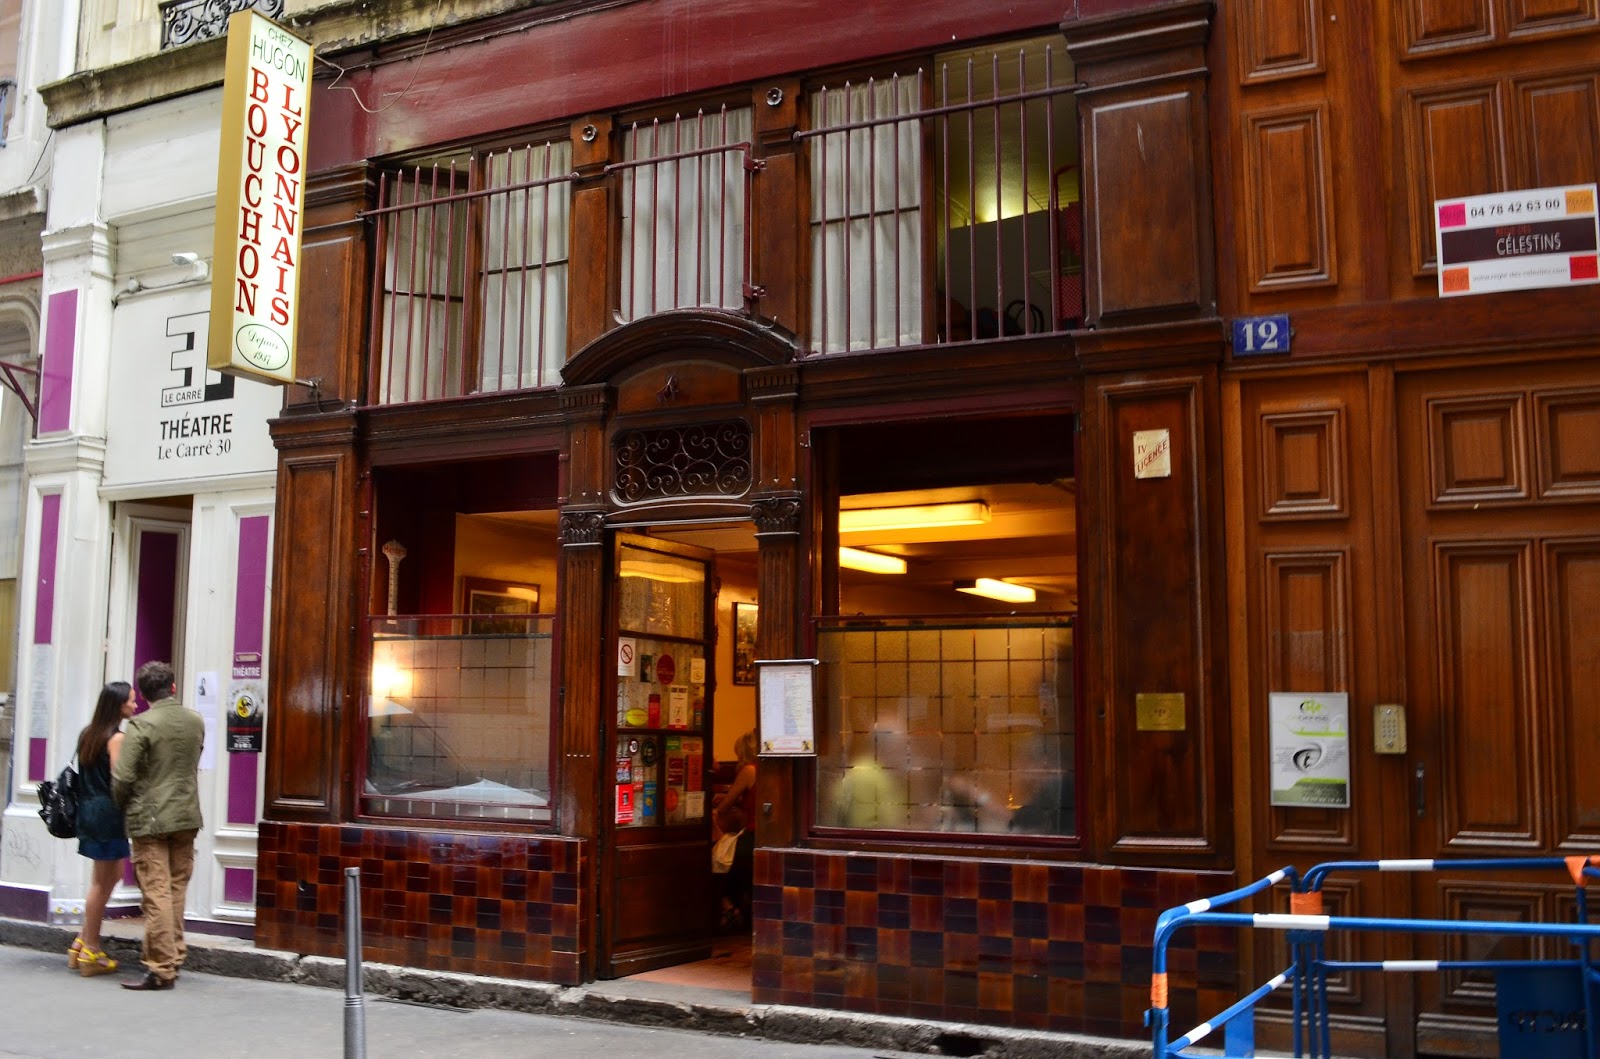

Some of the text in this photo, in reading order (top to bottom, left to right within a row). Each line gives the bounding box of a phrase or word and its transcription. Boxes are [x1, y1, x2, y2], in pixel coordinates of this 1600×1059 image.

[268, 28, 294, 51] CHEZ
[253, 35, 306, 83] HUGON
[235, 66, 269, 317] BOUCHON
[271, 83, 302, 326] LYONNAIS
[1470, 199, 1560, 218] 04 78 42 63 00
[1496, 232, 1562, 256] CÉLESTINS
[248, 329, 279, 350] Depuis
[1242, 320, 1278, 351] 12
[165, 389, 202, 404] LE CARRÉ
[160, 411, 233, 440] THÉATRE
[158, 438, 231, 460] Le Carré 30
[1137, 440, 1167, 472] LICENCE
[1138, 444, 1147, 454] IV
